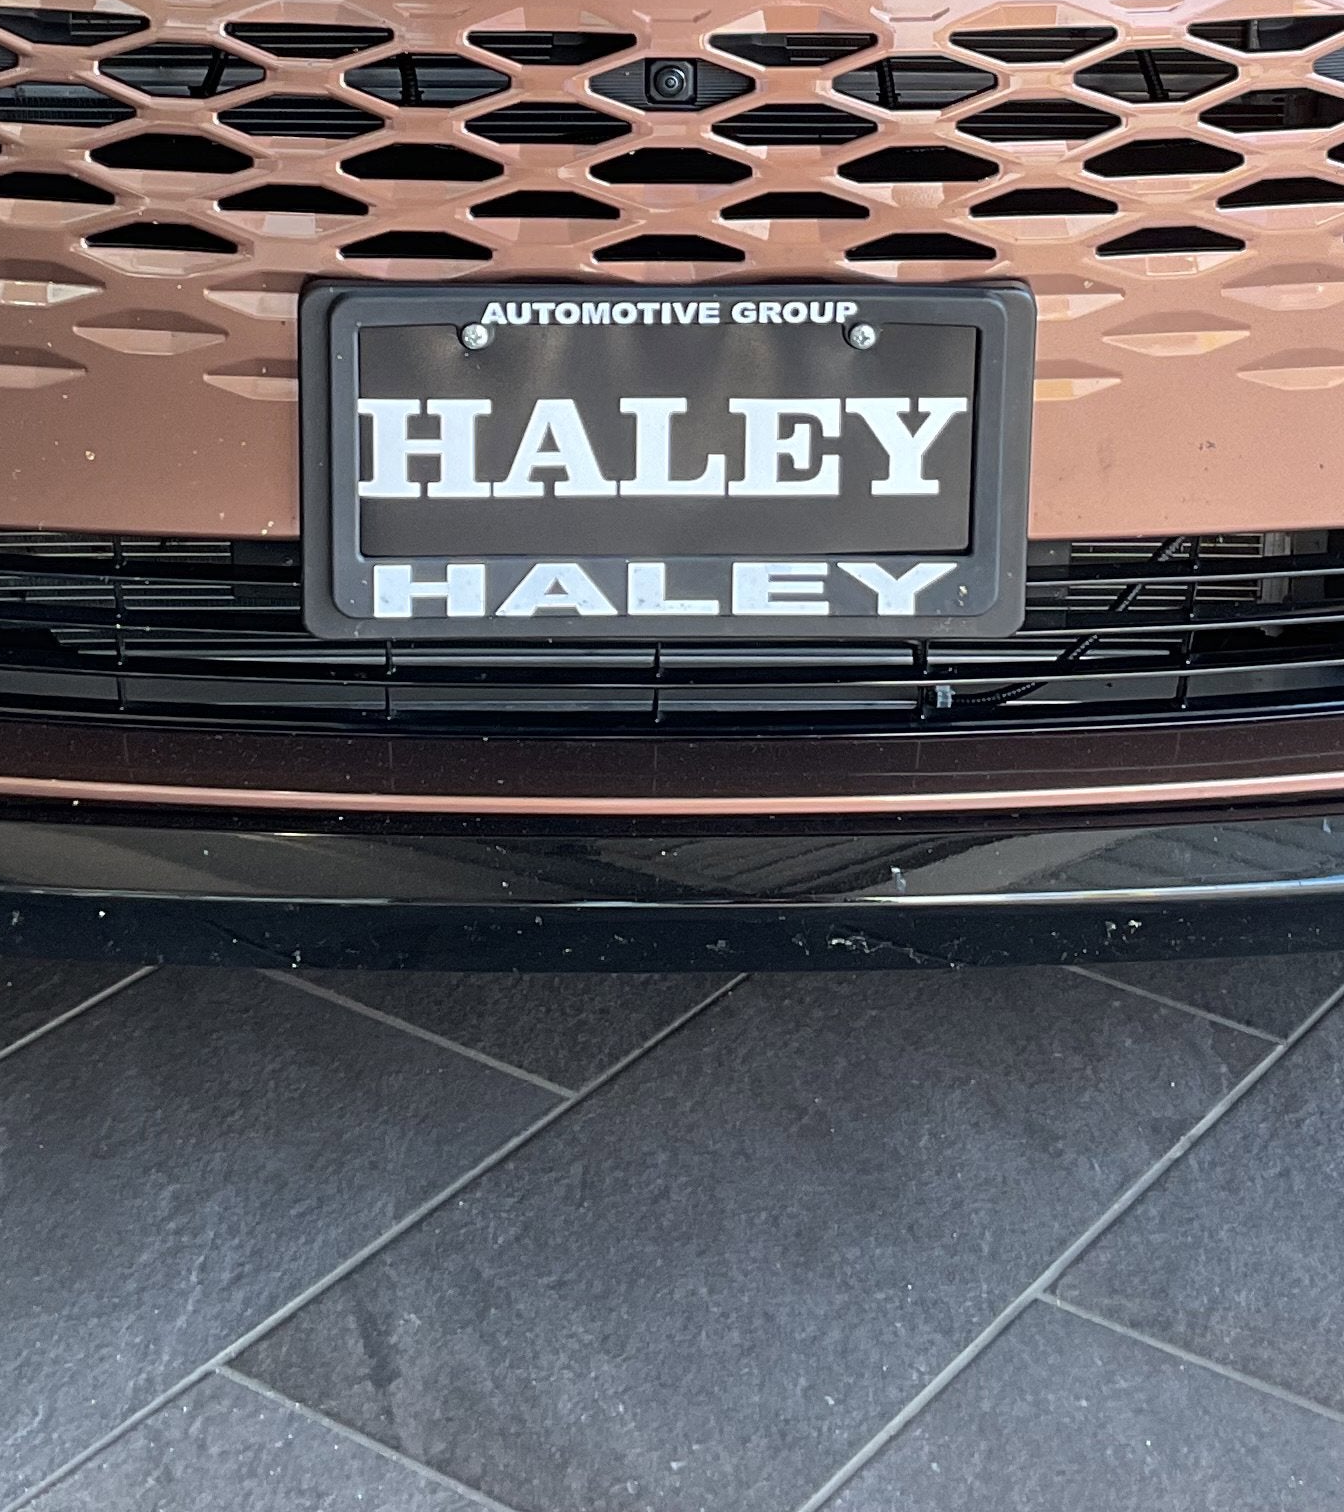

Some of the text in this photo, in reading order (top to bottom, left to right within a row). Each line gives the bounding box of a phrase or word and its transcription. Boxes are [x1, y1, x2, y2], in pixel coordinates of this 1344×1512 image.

[481, 301, 858, 325] AUTOMOTIVE GROUP
[357, 397, 968, 498] HALEY
[373, 562, 958, 618] HALEY
